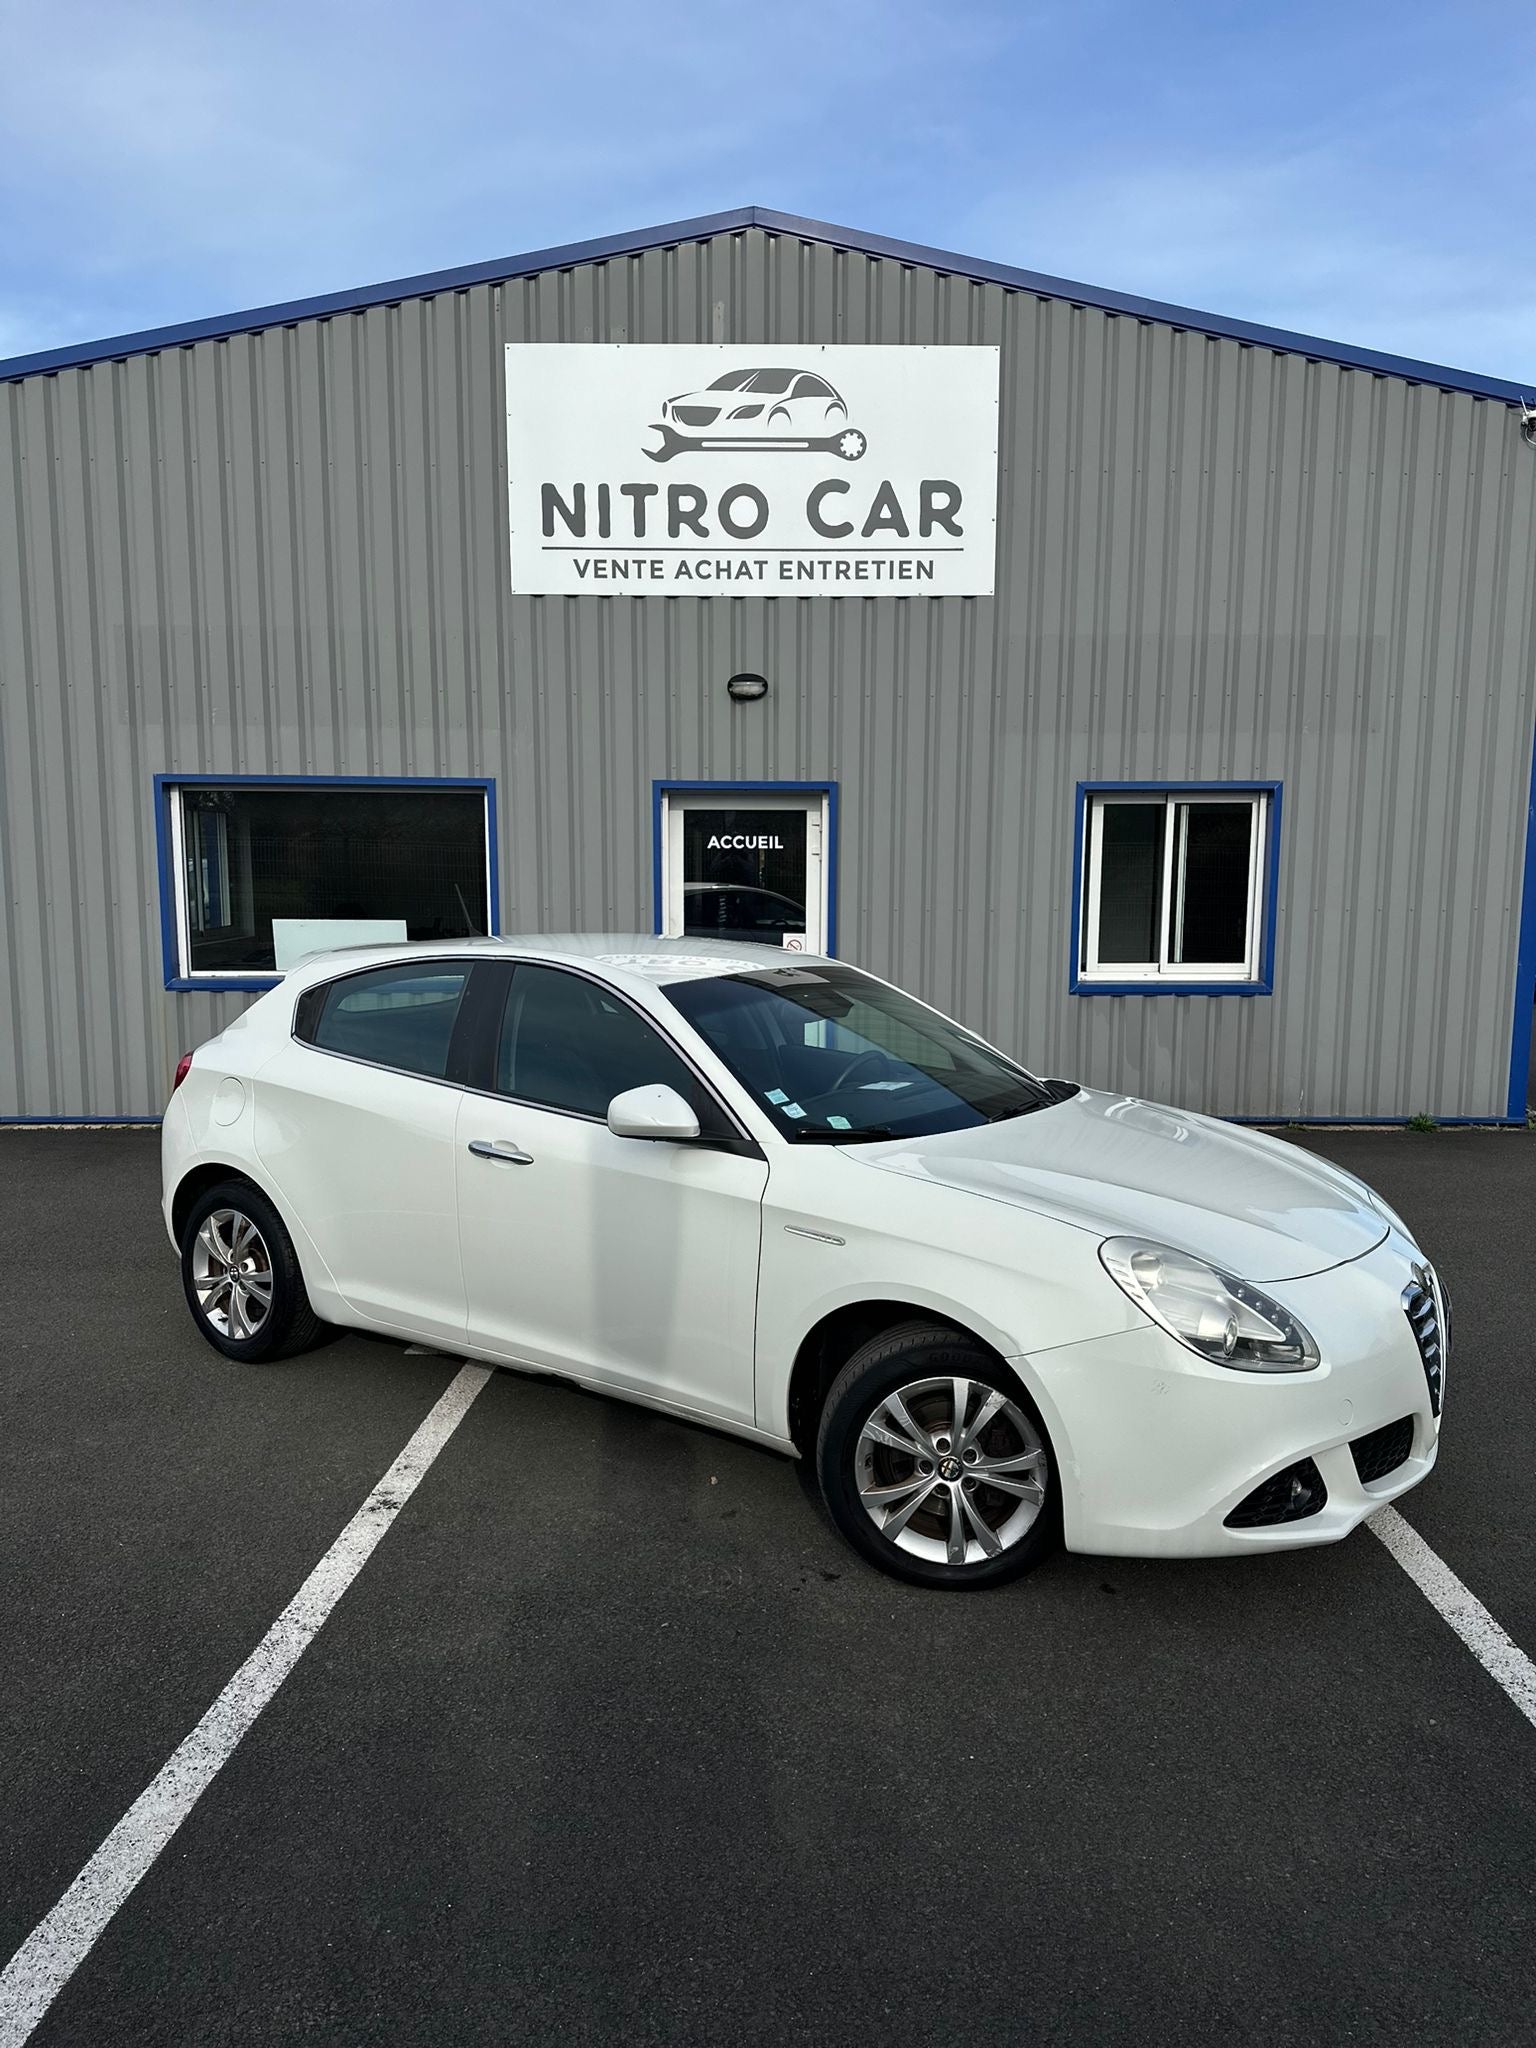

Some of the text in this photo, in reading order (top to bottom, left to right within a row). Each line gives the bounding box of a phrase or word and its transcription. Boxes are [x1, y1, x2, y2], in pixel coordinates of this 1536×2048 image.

[541, 478, 963, 539] NITRO CAR
[572, 558, 935, 580] VENTE ACHAT ENTRETIEN
[707, 835, 784, 849] ACCUEIL
